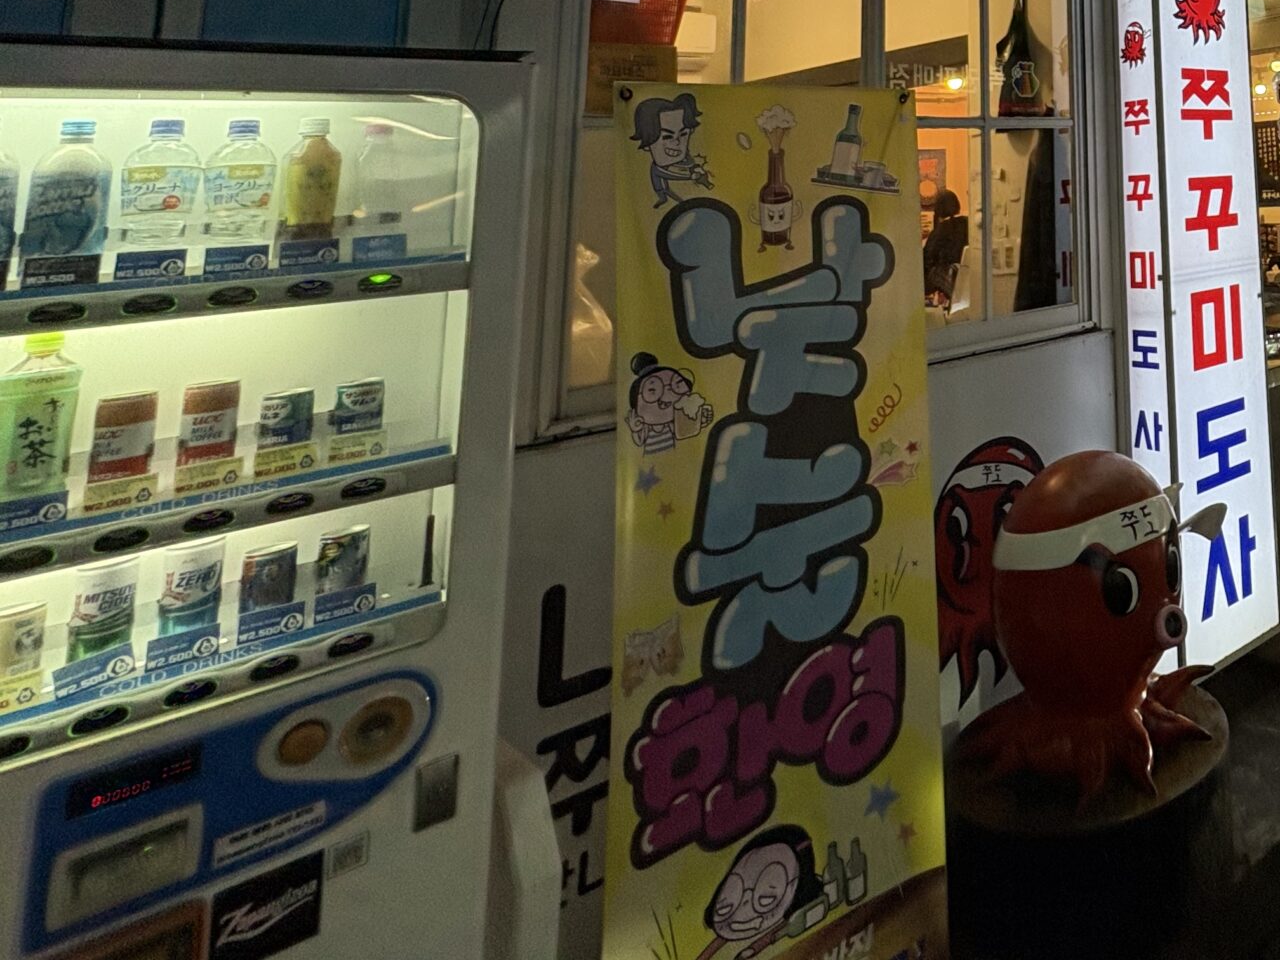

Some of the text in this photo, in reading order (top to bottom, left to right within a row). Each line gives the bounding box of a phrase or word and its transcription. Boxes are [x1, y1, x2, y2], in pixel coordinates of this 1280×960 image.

[1123, 99, 1163, 452] 쭈꾸미도사
[1181, 68, 1258, 622] 쭈꾸미도사
[18, 416, 57, 469] お茶
[192, 414, 225, 426] UCC
[121, 479, 280, 520] COLD DRINKS
[1119, 504, 1161, 541] 쭈도
[100, 642, 264, 698] COLD DRINKS
